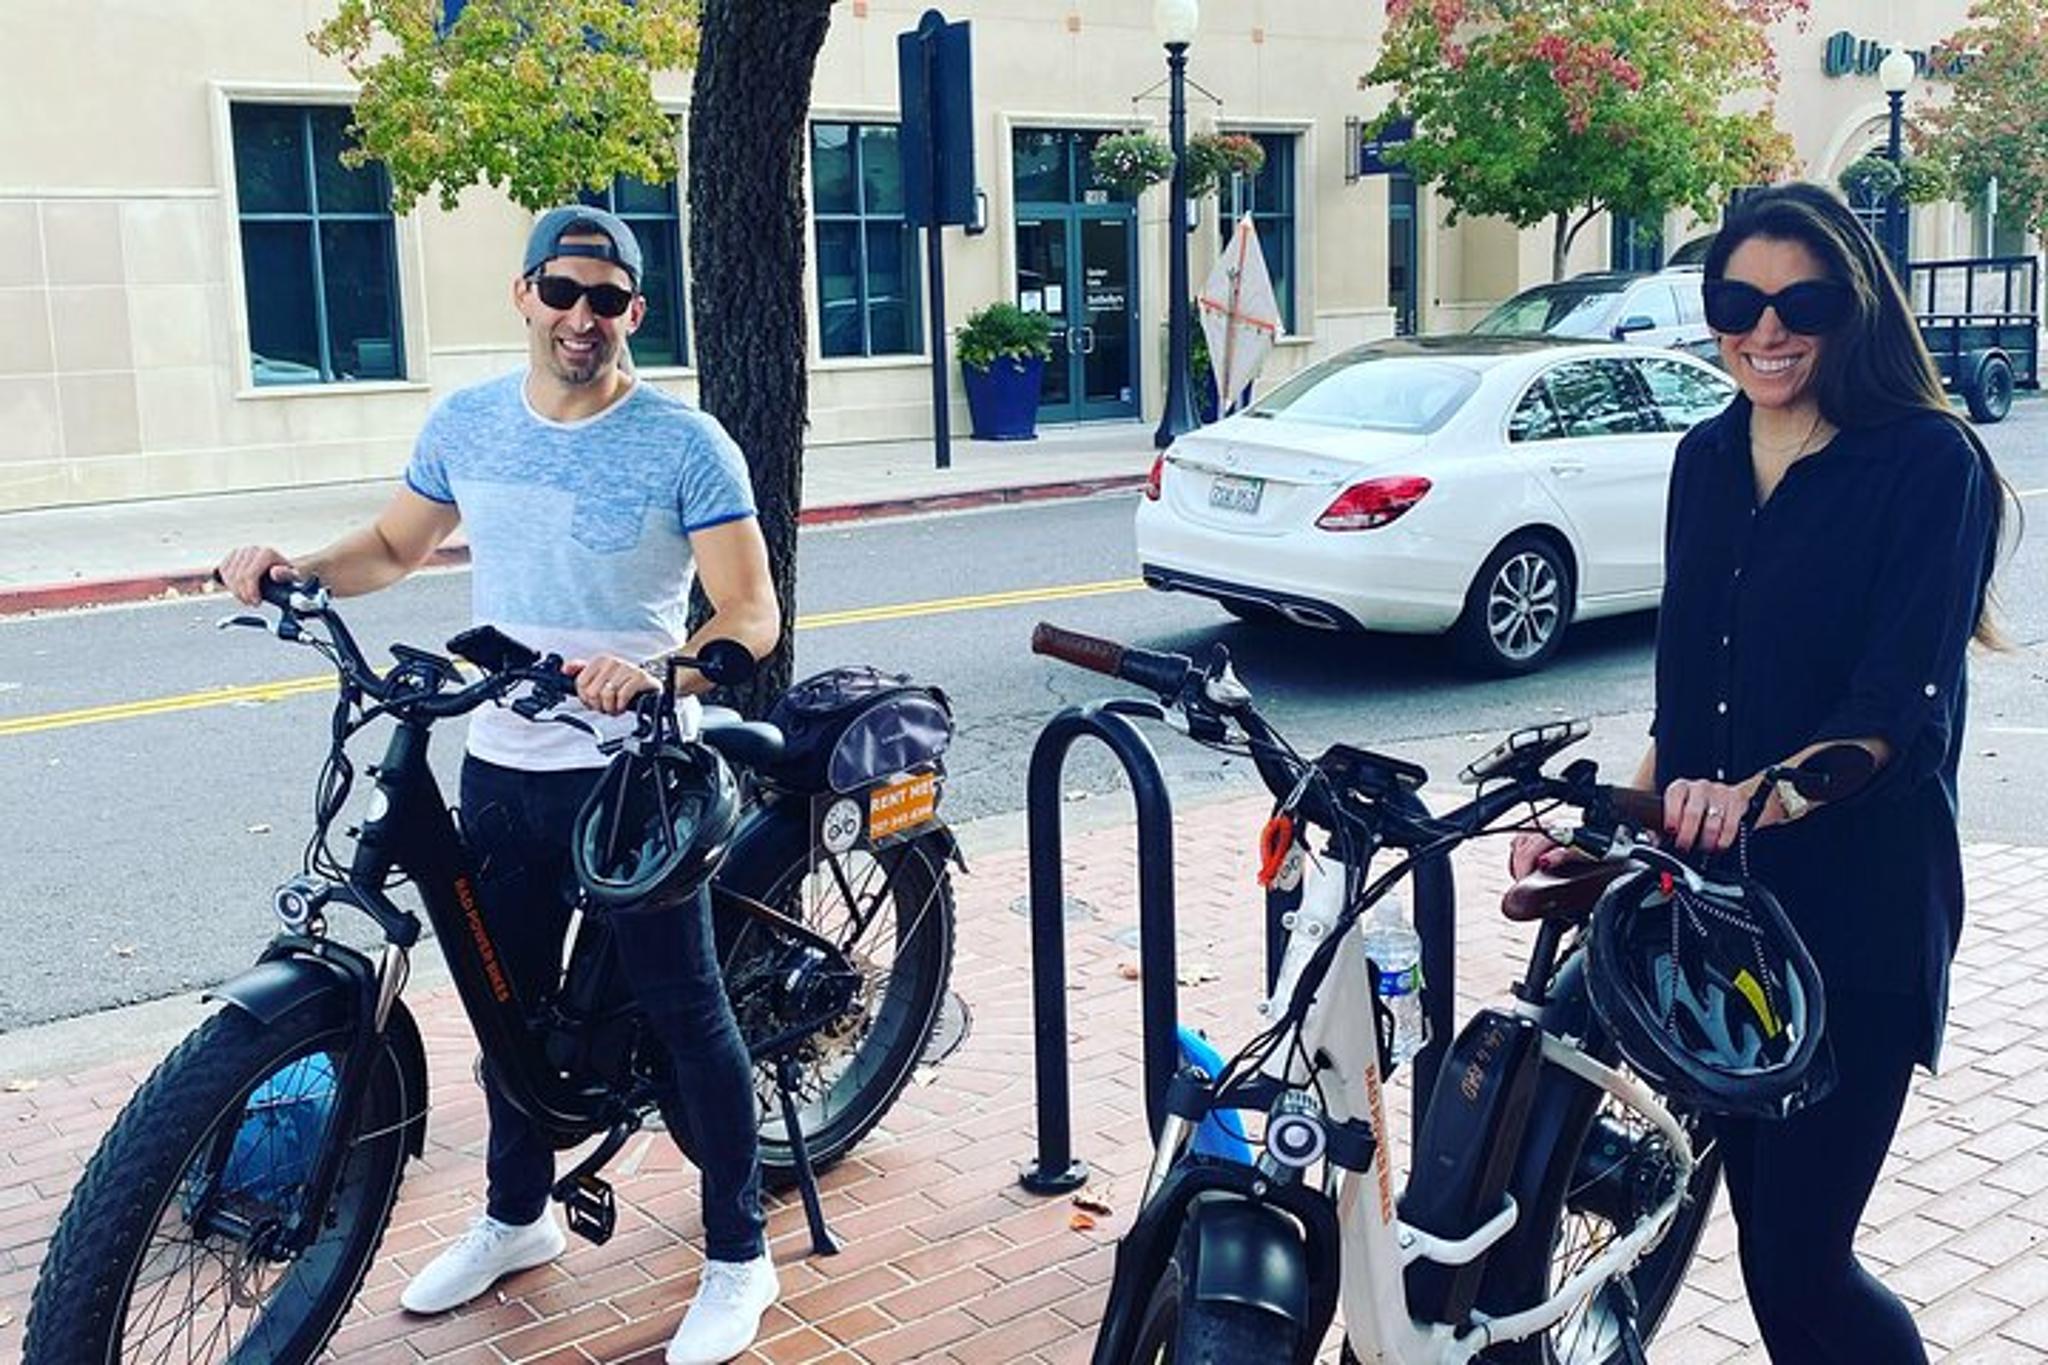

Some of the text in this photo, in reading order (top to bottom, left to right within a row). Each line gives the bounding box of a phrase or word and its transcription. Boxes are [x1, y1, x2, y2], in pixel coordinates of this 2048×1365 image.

[870, 788, 906, 810] RENT
[454, 877, 511, 1002] RAD POWER BIKES
